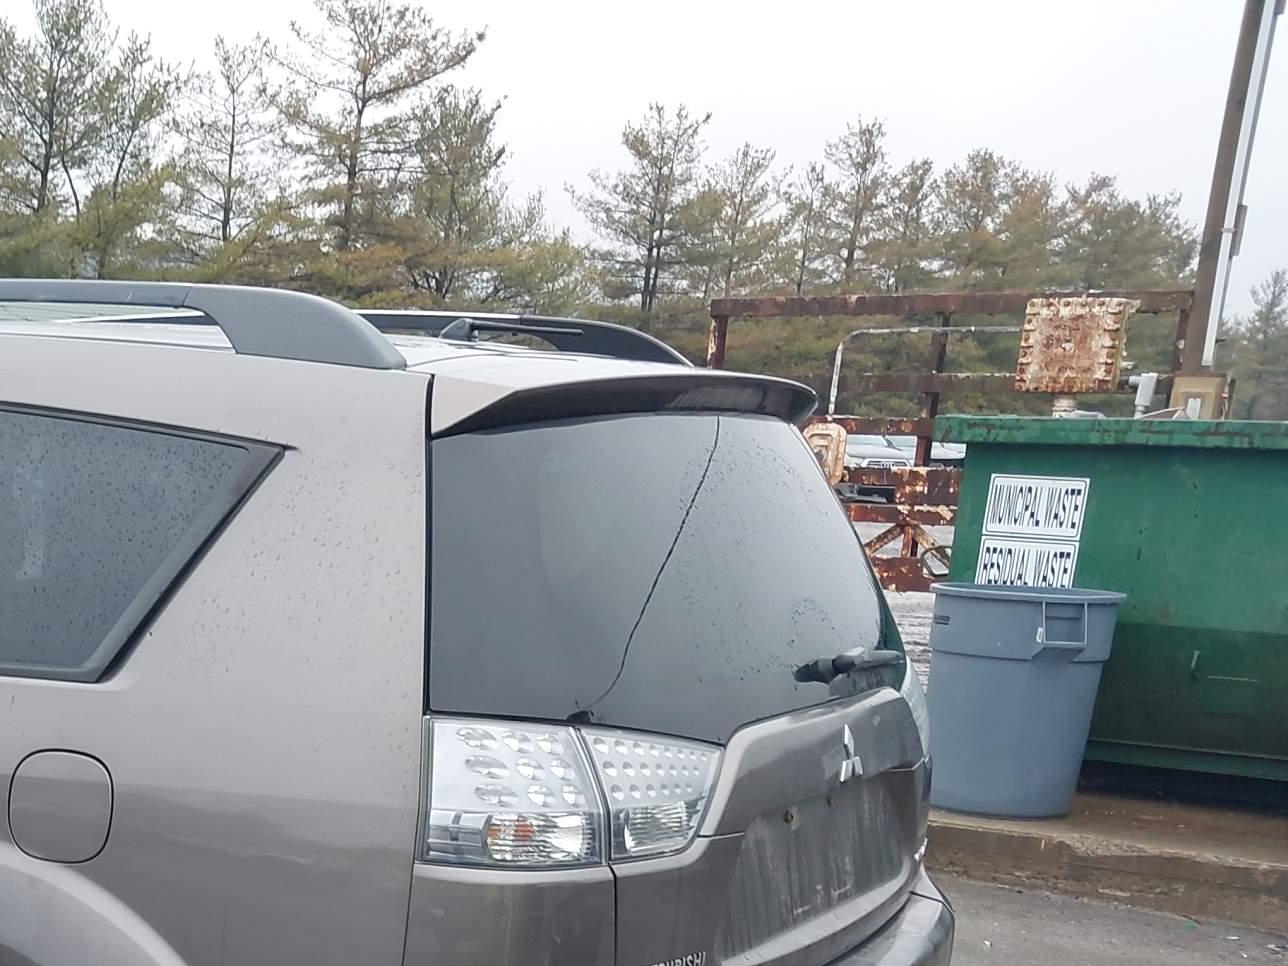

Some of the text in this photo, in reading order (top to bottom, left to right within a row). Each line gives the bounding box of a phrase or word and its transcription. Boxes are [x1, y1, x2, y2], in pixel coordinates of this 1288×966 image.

[990, 484, 1082, 529] MUNICIPAL WASTE
[980, 547, 1072, 588] RESIDUAL WASTE
